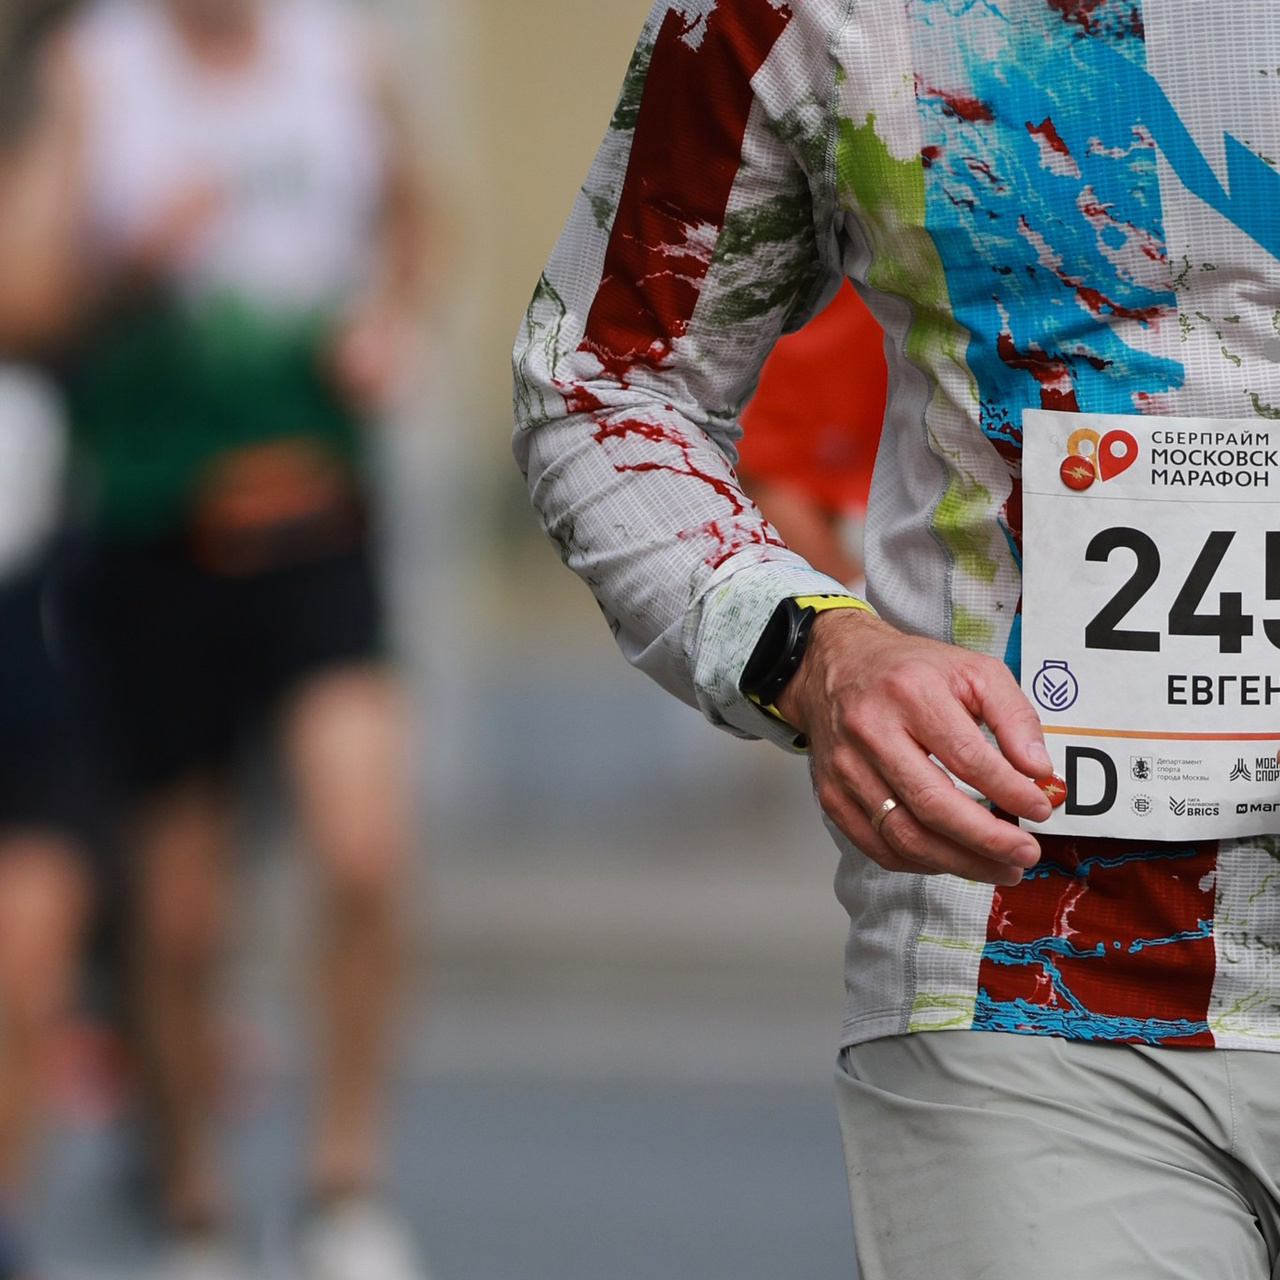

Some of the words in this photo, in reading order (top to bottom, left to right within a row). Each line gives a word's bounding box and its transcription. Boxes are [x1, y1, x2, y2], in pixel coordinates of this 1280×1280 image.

[1151, 430, 1269, 446] СБЕРПРАЙМ
[1151, 469, 1269, 487] МАРАФОН
[1156, 758, 1203, 766] Департамент
[1065, 746, 1118, 816] D
[1187, 807, 1220, 816] BRICS
